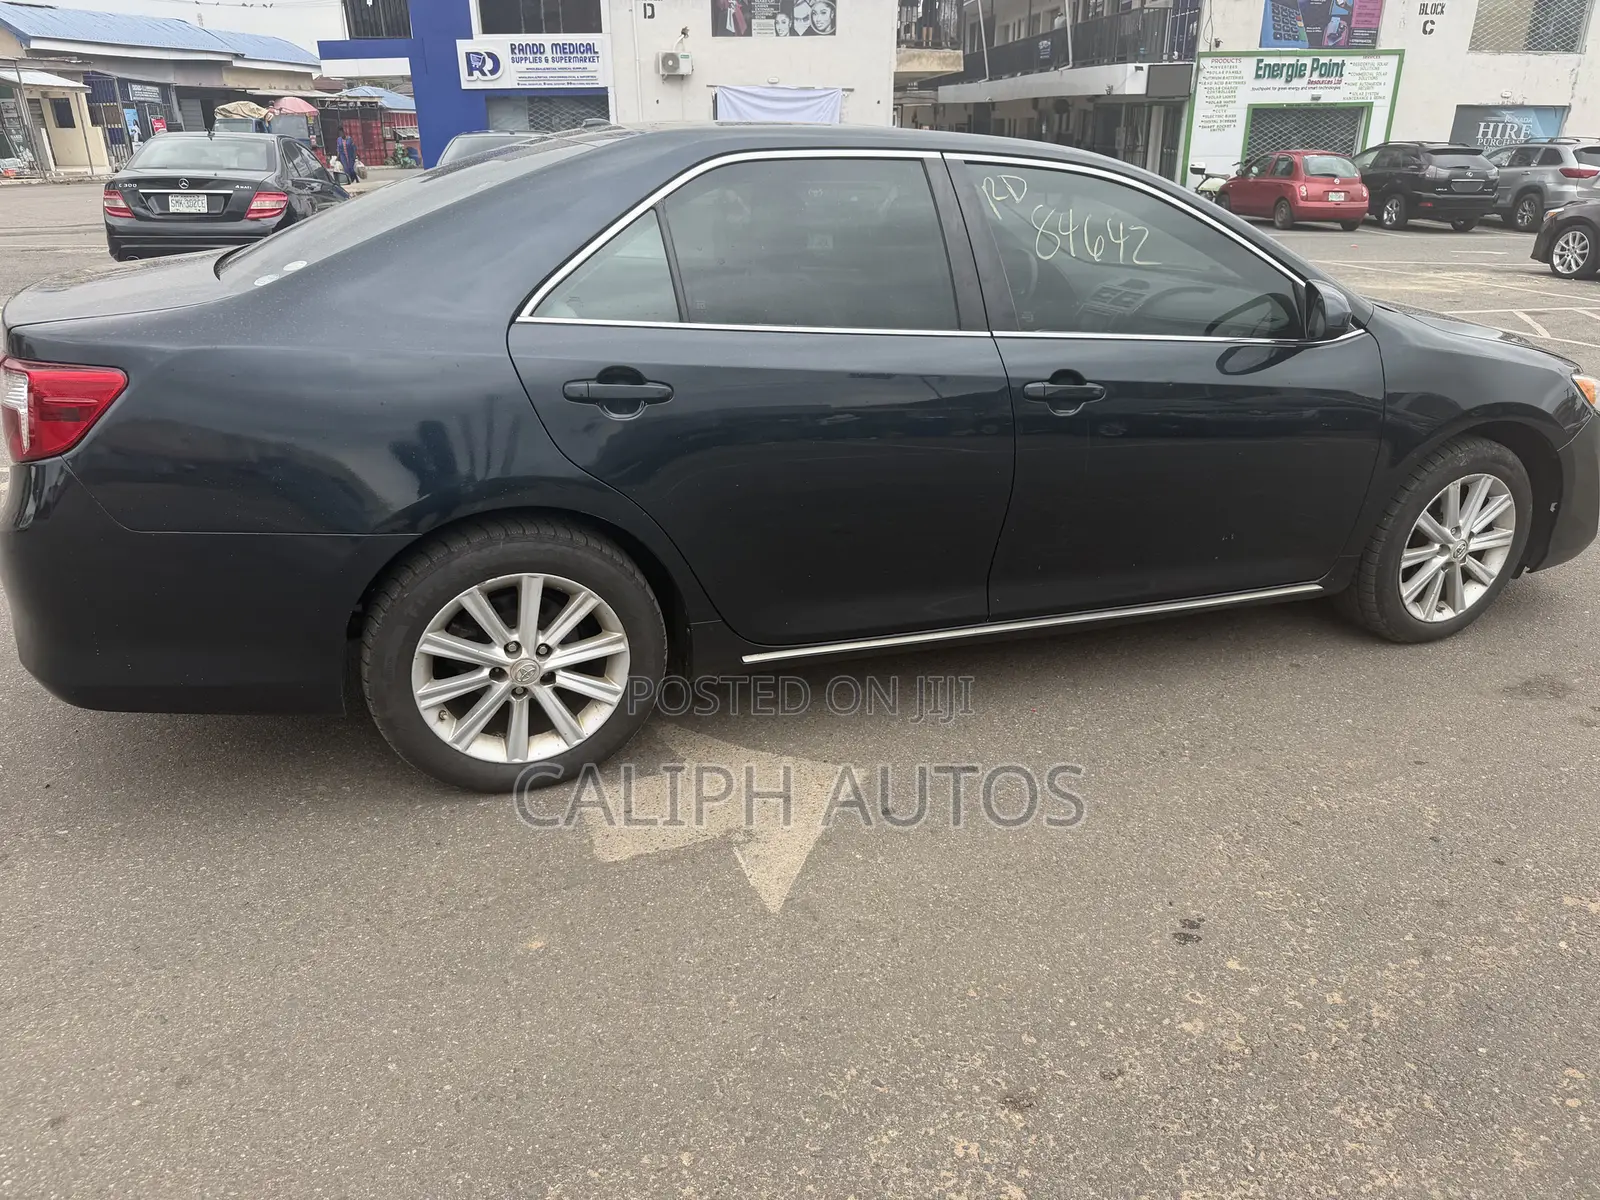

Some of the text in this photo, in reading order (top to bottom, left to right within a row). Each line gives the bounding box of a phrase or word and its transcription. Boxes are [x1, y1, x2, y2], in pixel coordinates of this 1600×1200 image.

[643, 3, 655, 19] D
[1418, 3, 1446, 15] BLOCK
[1422, 19, 1435, 35] C
[509, 42, 599, 55] RANDD MEDICAL
[465, 51, 501, 77] RD
[510, 55, 600, 64] SUPPLIES & SUPERMARKET
[1254, 58, 1346, 83] Energie Point
[1476, 122, 1533, 140] HIRE
[1031, 204, 1162, 265] 84642
